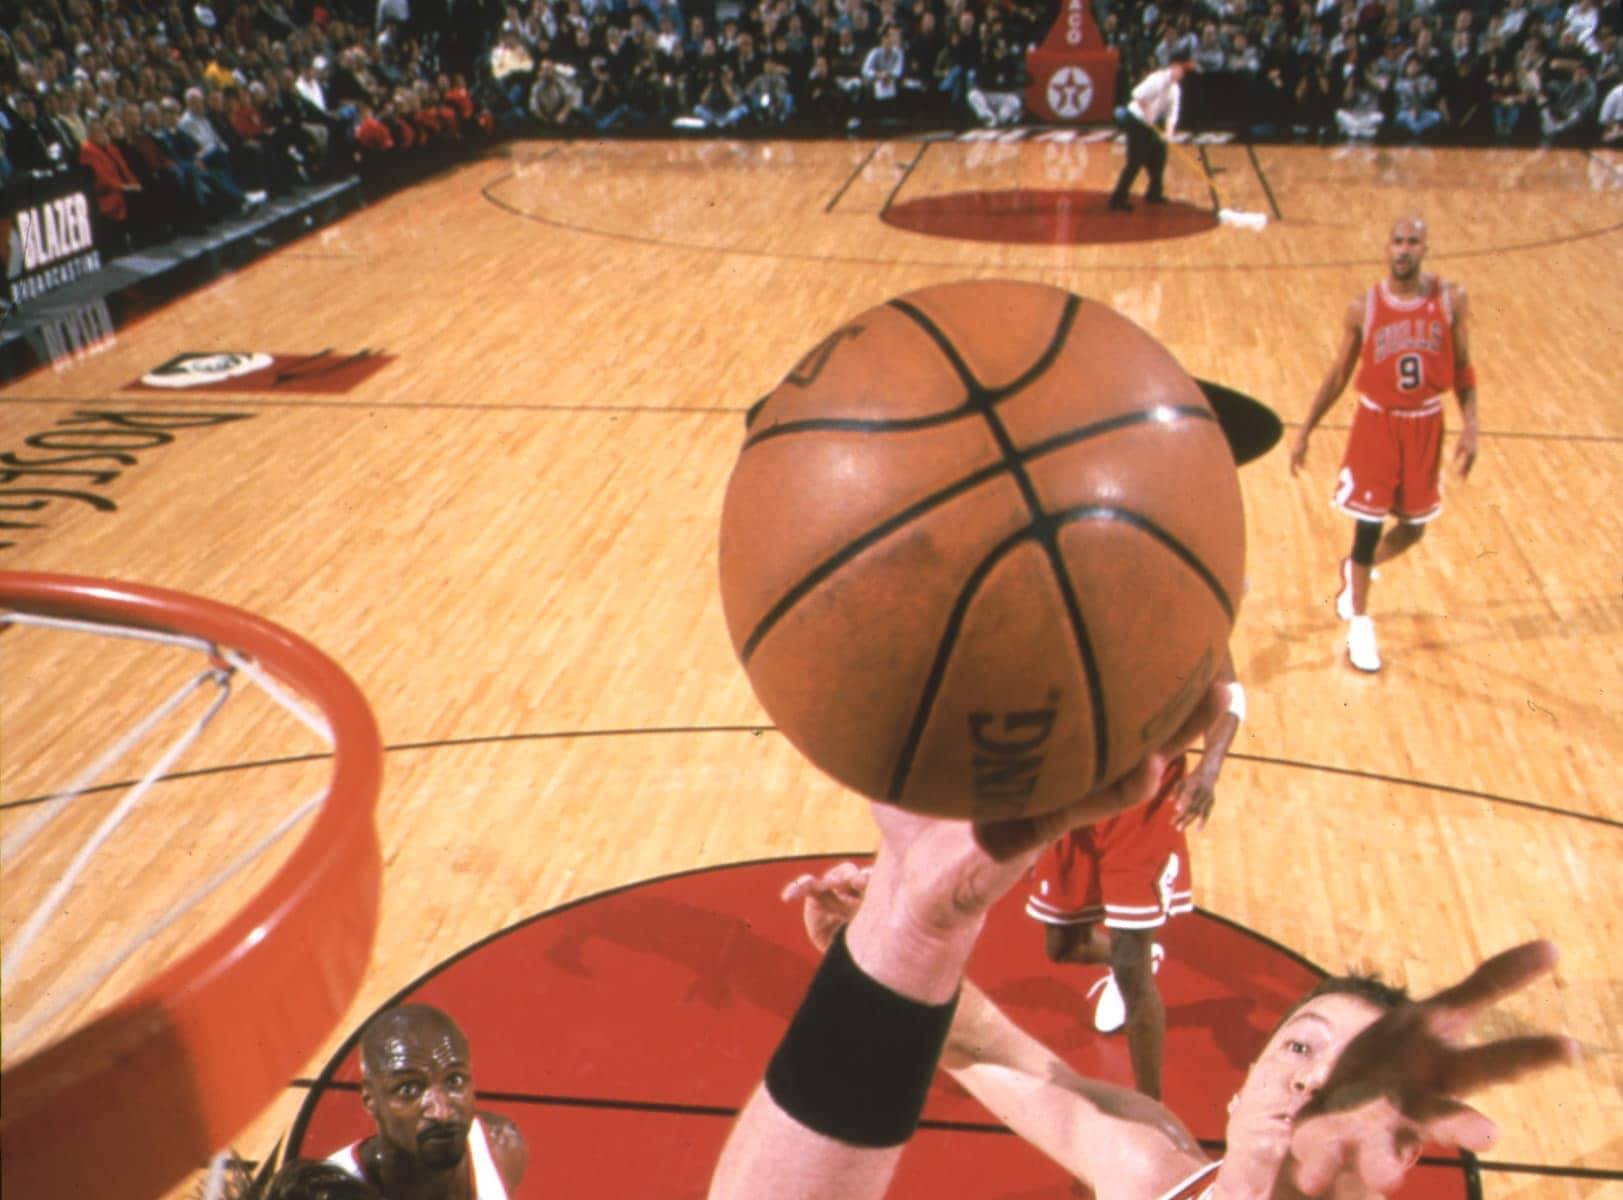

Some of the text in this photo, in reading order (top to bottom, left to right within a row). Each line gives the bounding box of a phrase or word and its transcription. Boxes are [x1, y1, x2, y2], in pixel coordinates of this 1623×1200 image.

[16, 192, 93, 270] BLAZER
[1375, 319, 1442, 364] BULLS
[1397, 352, 1425, 392] 9
